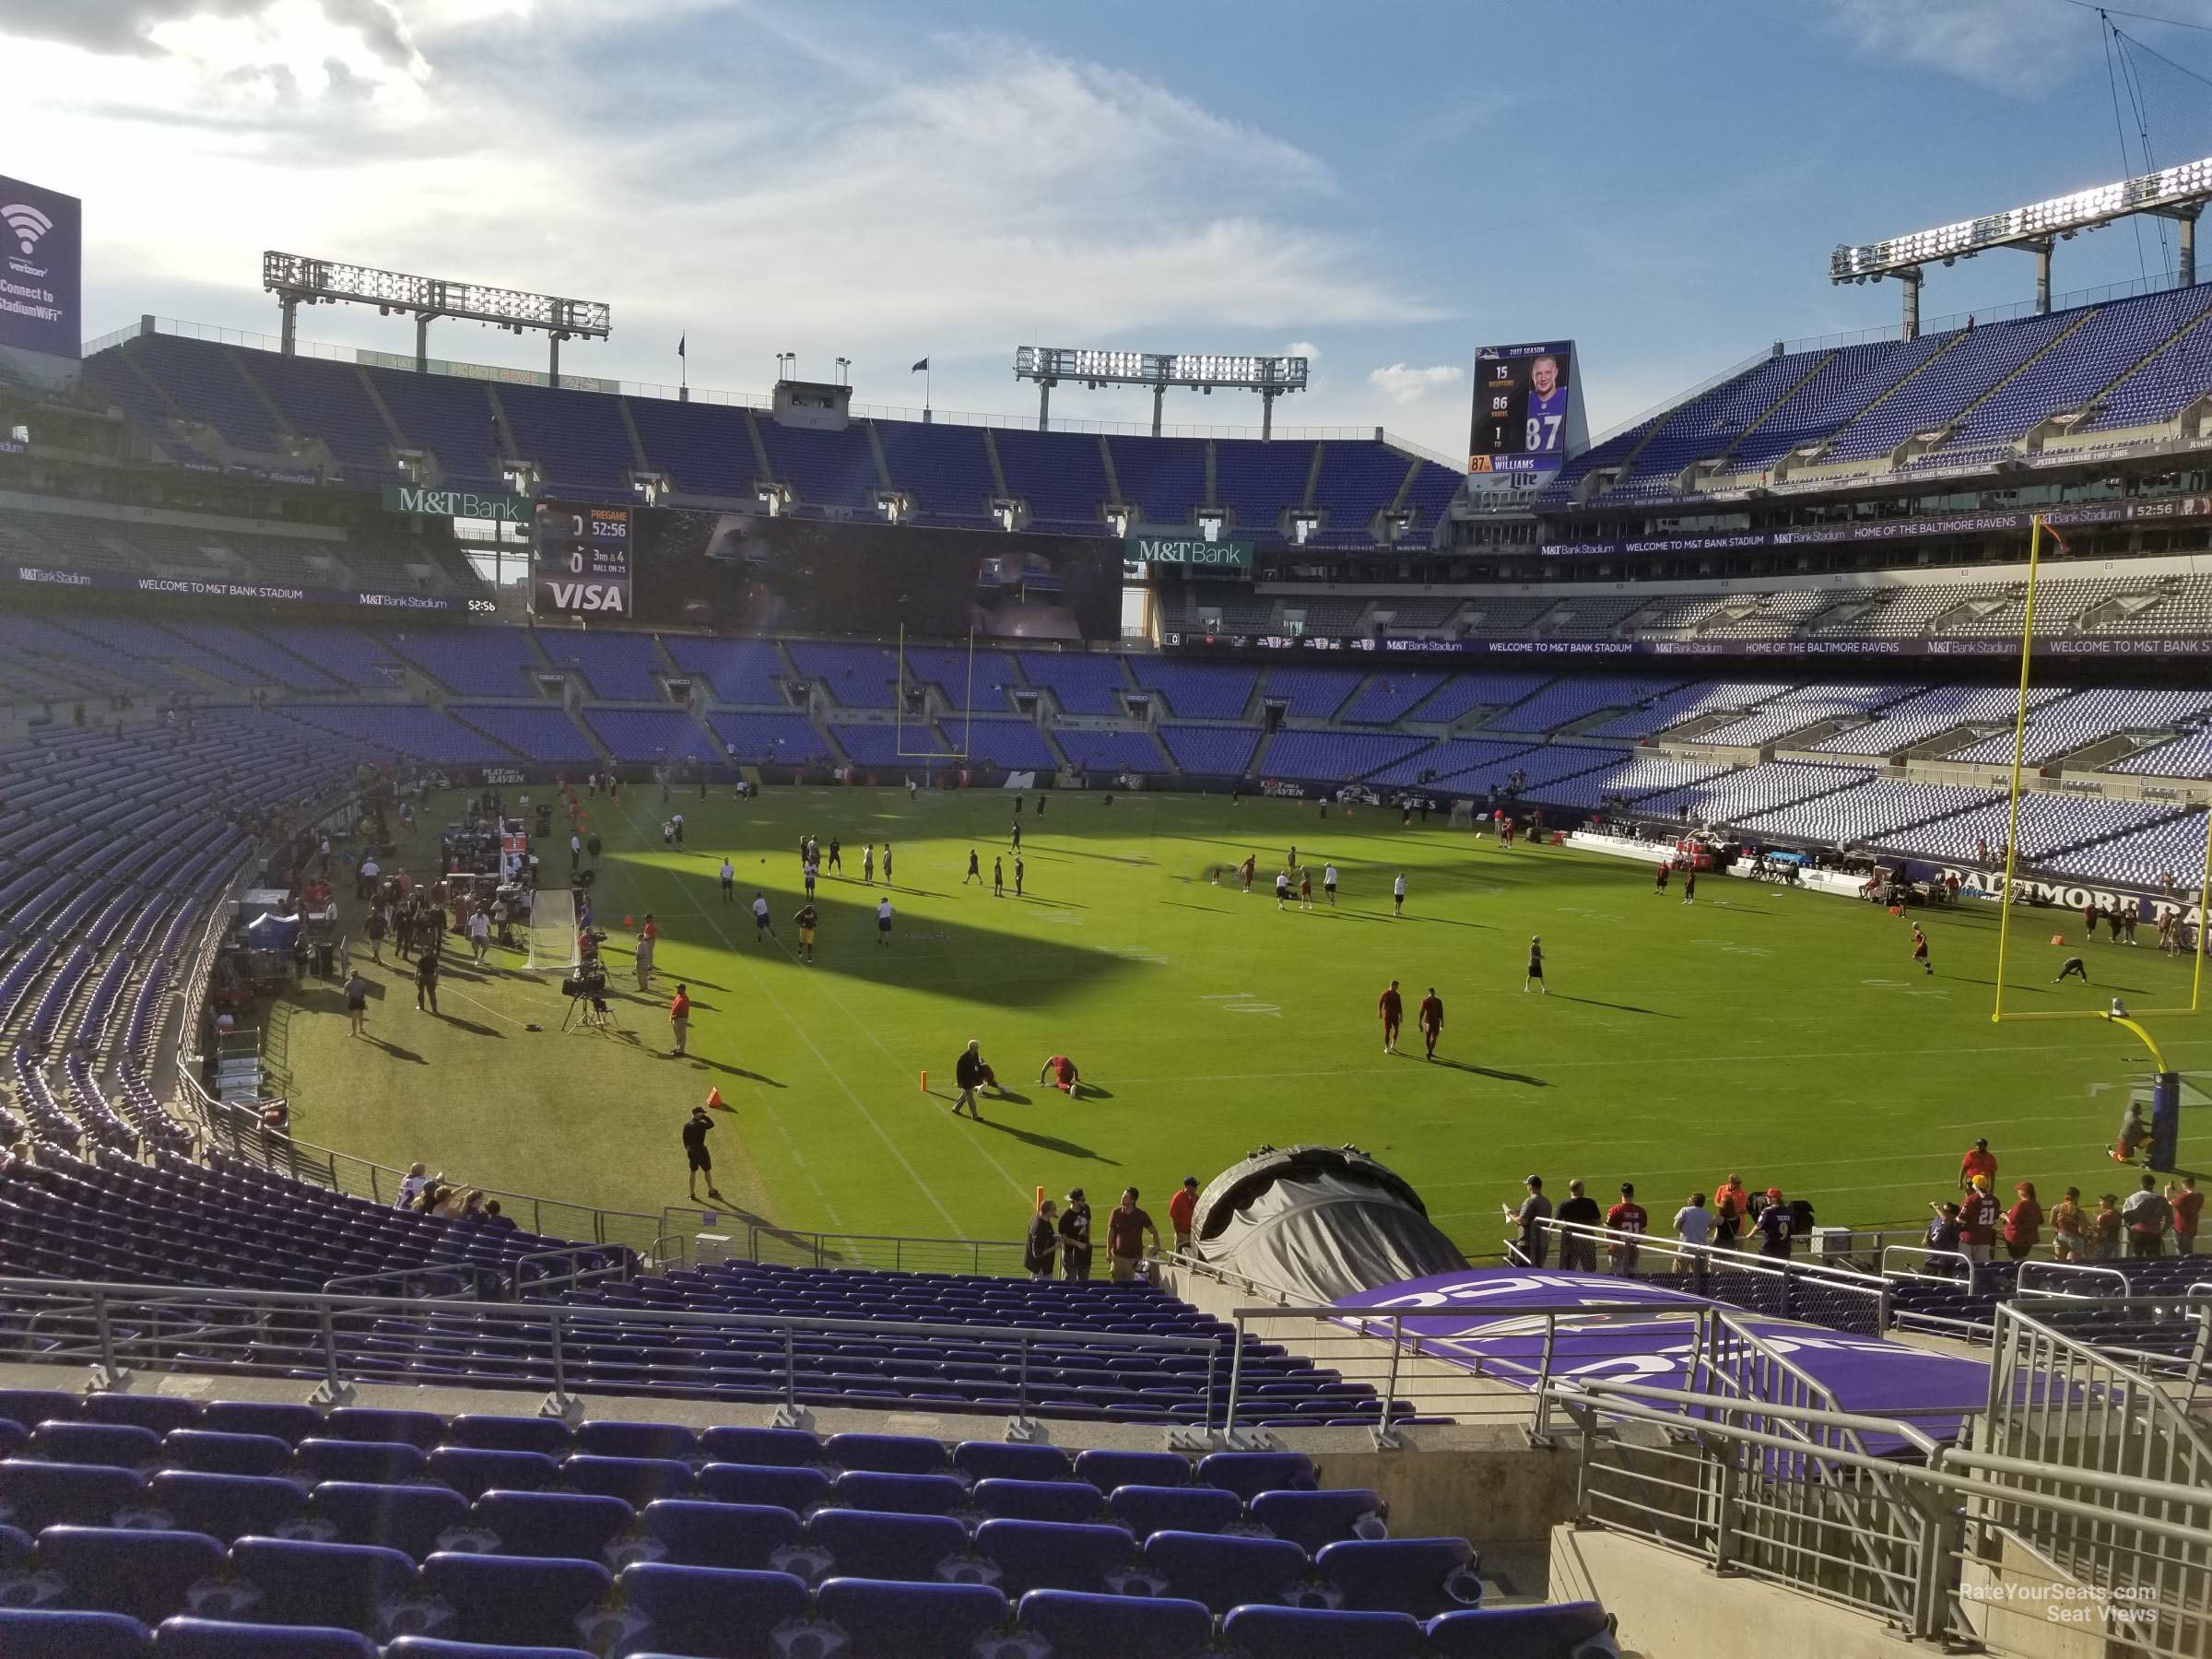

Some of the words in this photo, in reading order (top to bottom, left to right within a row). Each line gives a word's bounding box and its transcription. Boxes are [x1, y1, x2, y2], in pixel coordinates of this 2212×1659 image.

[9, 263, 45, 277] verizon
[0, 279, 41, 300] Connect
[43, 289, 53, 302] to
[1524, 347, 1546, 355] SEASON
[1497, 366, 1508, 379] 15
[1493, 396, 1508, 410] 86
[1496, 427, 1500, 441] 1
[1526, 415, 1562, 451] 87
[1472, 457, 1485, 472] 87
[1495, 460, 1534, 471] WILLIAMS
[1510, 472, 1537, 489] Lite
[398, 488, 460, 514] M&T
[464, 494, 518, 520] Bank
[2137, 504, 2172, 516] 52:56
[591, 510, 628, 521] PREGAME
[2054, 512, 2079, 524] Bank
[2079, 509, 2121, 522] Stadium
[593, 522, 627, 537] 52:56
[1854, 527, 1881, 538] HOME
[1884, 525, 1896, 535] OF
[1900, 524, 1917, 535] THE
[1920, 520, 1973, 534] BALTIMORE
[1976, 516, 2017, 529] RAVENS
[1626, 541, 1667, 552] WELCOME
[1670, 540, 1682, 549] TO
[1684, 539, 1702, 549] M&T
[1705, 537, 1727, 548] BANK
[1729, 535, 1764, 547] STADIUM
[1773, 532, 1793, 544] M&T
[1794, 532, 1812, 543] Bank
[1813, 530, 1845, 541] Stadium
[593, 549, 608, 561] 3RD
[617, 551, 624, 562] 4
[1139, 541, 1190, 562] M&T
[1193, 543, 1241, 564] Bank
[1541, 546, 1561, 556] M&T
[1561, 545, 1580, 554] Bank
[1582, 544, 1614, 554] Stadium
[571, 552, 582, 573] 0
[594, 564, 606, 572] BALL
[19, 567, 40, 581] M&T
[56, 571, 90, 585] Stadium
[139, 579, 188, 592] WELCOME
[192, 582, 205, 593] TO
[206, 584, 227, 594] M&T
[230, 586, 257, 597] BANK
[259, 587, 302, 599] STADIUM
[359, 594, 383, 606] M&T
[384, 595, 407, 607] Bank
[408, 597, 447, 610] Stadium
[546, 582, 623, 611] VISA
[468, 600, 496, 611] 52:56
[1386, 641, 1408, 650] M&T
[1408, 641, 1428, 651] Bank
[1429, 641, 1462, 652] Stadium
[1489, 642, 1533, 653] WELCOME
[1535, 642, 1547, 653] TO
[1549, 642, 1569, 653] M&T
[1571, 643, 1593, 653] BANK
[1594, 643, 1631, 653] STADIUM
[1674, 642, 1692, 653] Bank
[1692, 642, 1723, 653] Stadium
[1746, 642, 1771, 653] HOME
[1774, 642, 1786, 653] OF
[1788, 642, 1806, 653] THE
[1808, 642, 1859, 653] BALTIMORE
[1862, 642, 1899, 653] RAVENS
[1927, 641, 1952, 653] M&T
[1952, 641, 1976, 653] Bank
[1977, 641, 2016, 653] Stadium
[2051, 641, 2109, 653] WELCOME
[2113, 641, 2131, 653] TO
[2134, 641, 2161, 653] M&T
[2163, 641, 2198, 653] BANK
[488, 774, 524, 783] RAVEN
[1979, 1208, 1994, 1225] 21
[1780, 1222, 1788, 1241] 9
